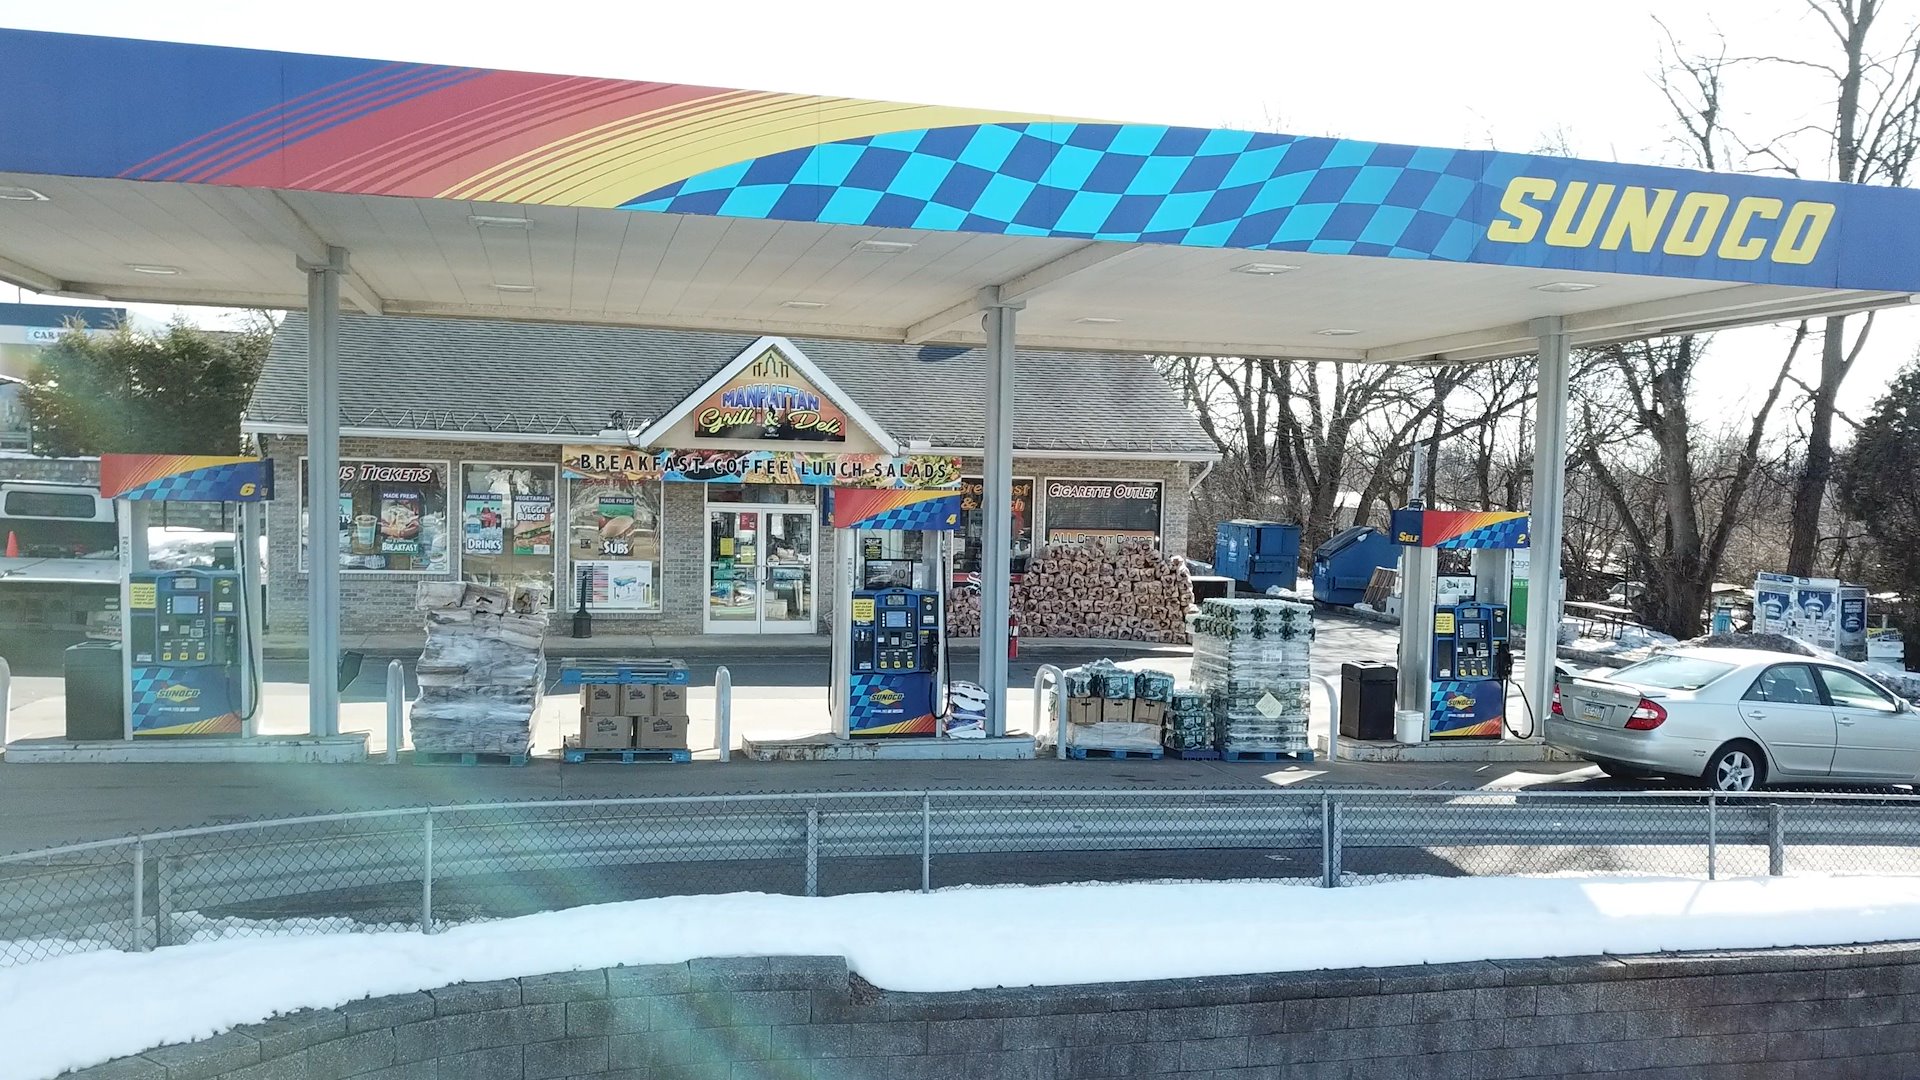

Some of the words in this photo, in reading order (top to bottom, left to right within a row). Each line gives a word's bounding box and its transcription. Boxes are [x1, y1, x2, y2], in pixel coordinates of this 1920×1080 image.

[1486, 176, 1836, 265] SUNOCO
[33, 330, 55, 340] CAR
[720, 383, 821, 411] MANHATTAN
[699, 407, 754, 434] Grill
[764, 411, 779, 426] &
[787, 410, 842, 434] Deli
[360, 463, 432, 482] TICKETS
[580, 454, 703, 474] BREAKFAST
[713, 458, 789, 475] COFFEE
[801, 461, 863, 477] LUNCH
[874, 462, 947, 479] SALADS
[239, 483, 256, 497] 6
[1049, 482, 1112, 499] CIGARETTE
[1113, 484, 1158, 500] OUTLET
[521, 504, 549, 513] VEGGIE
[517, 513, 546, 521] BURGER
[946, 514, 957, 525] 4
[1052, 533, 1075, 544] ALL
[1077, 533, 1114, 544] CDIT
[1398, 531, 1419, 543] SELF
[1517, 533, 1526, 545] 2
[382, 542, 418, 552] BREAKFAST
[467, 538, 502, 551] DRINKS
[603, 541, 629, 554] SUBS
[158, 689, 200, 698] SUNOCO
